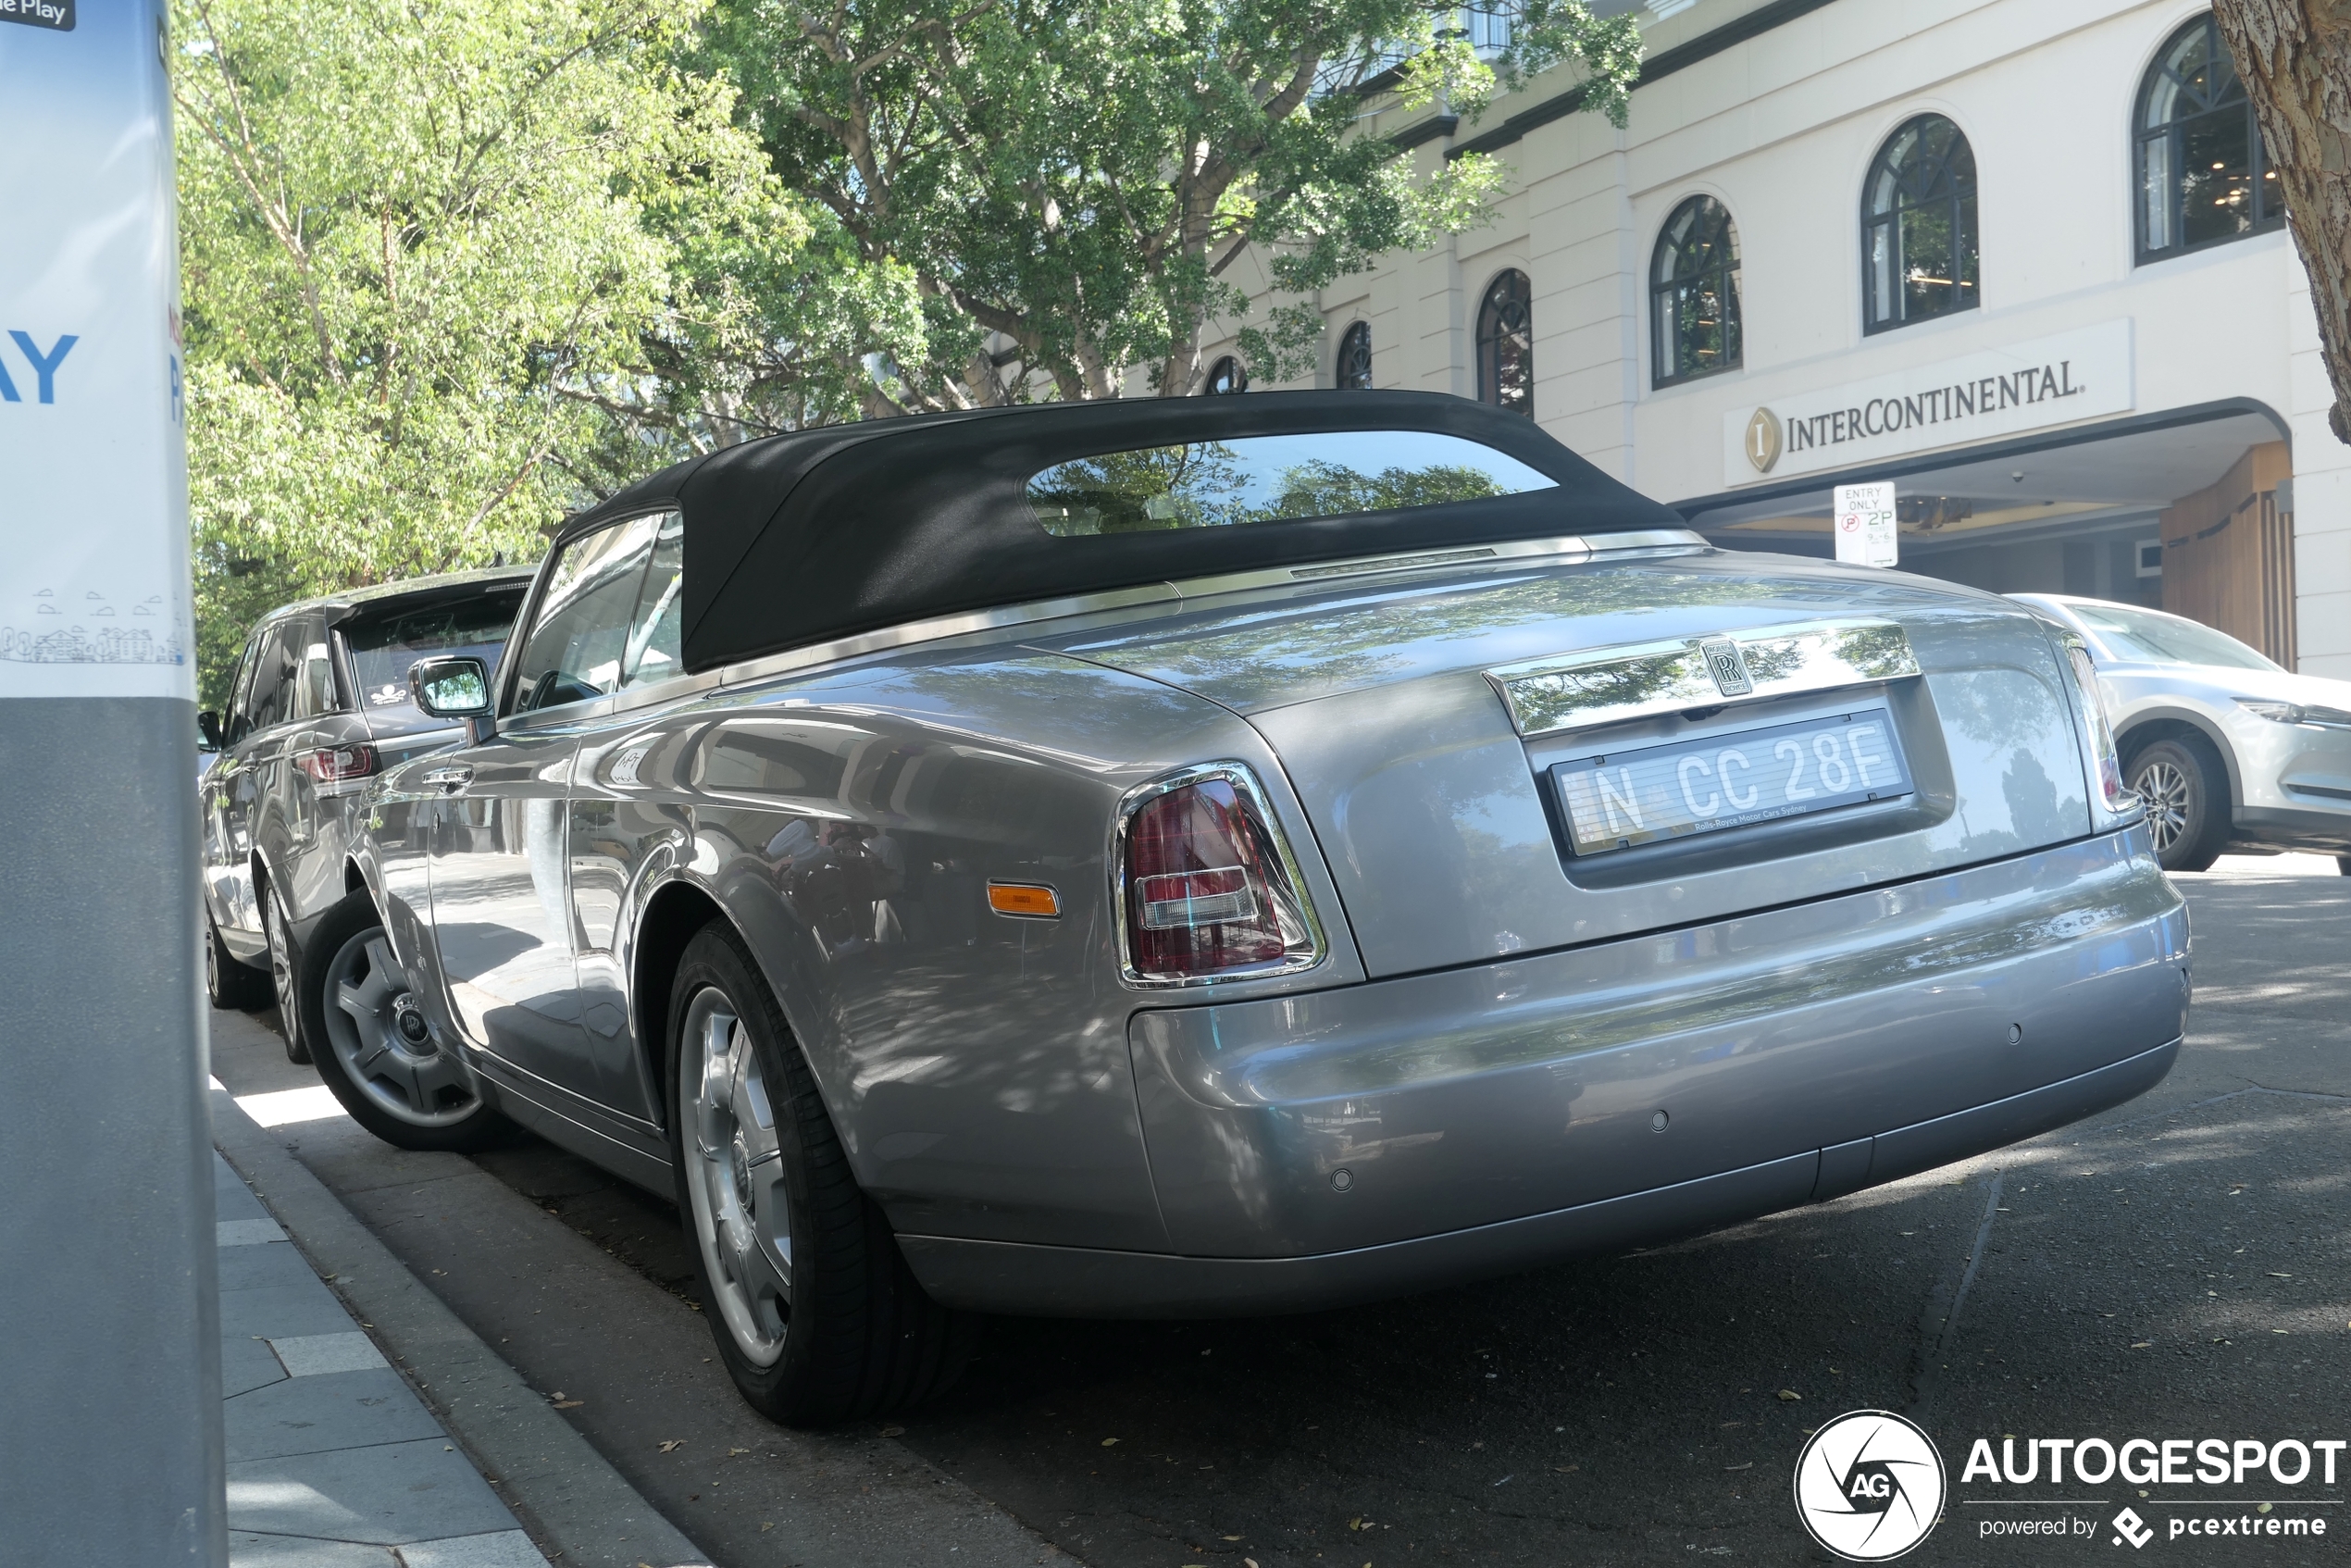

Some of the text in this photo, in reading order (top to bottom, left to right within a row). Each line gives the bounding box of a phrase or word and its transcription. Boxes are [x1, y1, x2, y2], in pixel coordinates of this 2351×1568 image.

[21, 0, 67, 25] Play
[0, 330, 80, 404] Y
[1846, 487, 1882, 500] ENTRY
[1849, 499, 1880, 511] ONLY
[1868, 511, 1893, 526] 2P
[1595, 725, 1883, 833] N CC 28F
[1695, 804, 1807, 831] Rolls-Royce Motor Cars Sydney
